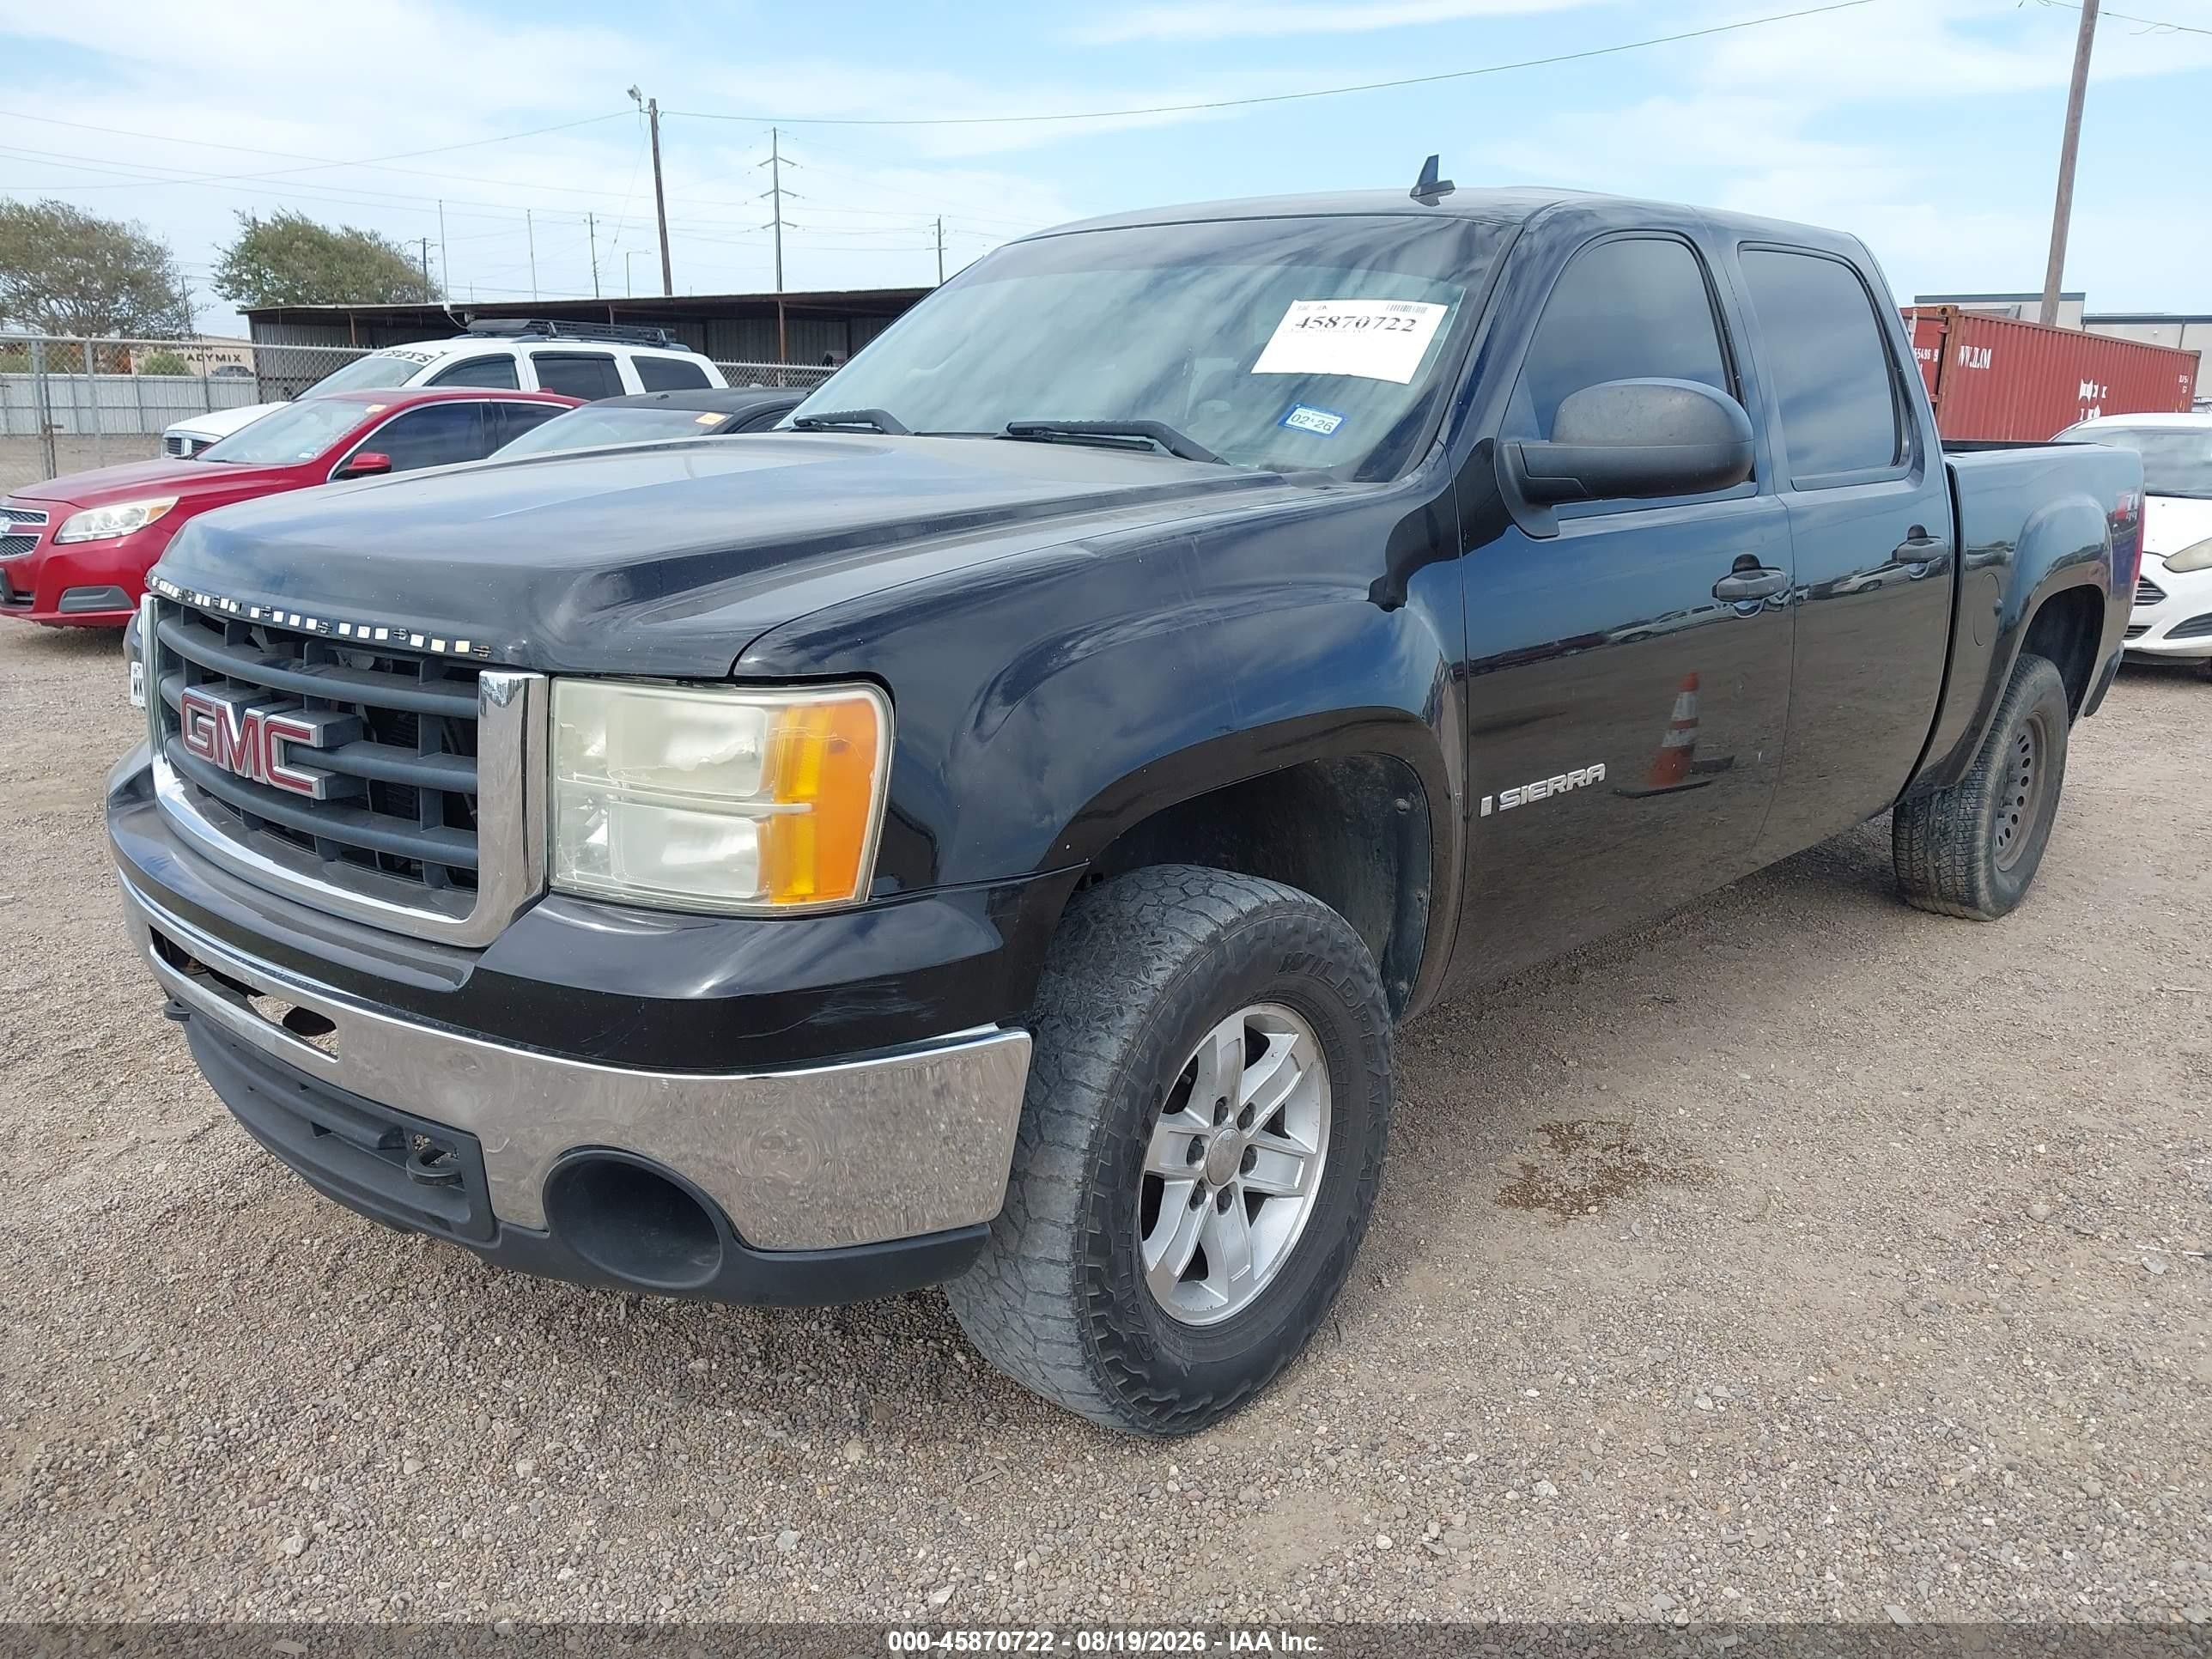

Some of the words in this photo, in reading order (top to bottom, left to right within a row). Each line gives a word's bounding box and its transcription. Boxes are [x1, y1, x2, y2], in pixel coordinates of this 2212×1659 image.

[1294, 315, 1417, 332] 45870722
[1291, 414, 1310, 425] 02
[1313, 419, 1334, 432] 26
[180, 686, 327, 800] GMC
[1498, 763, 1607, 811] SIERRA
